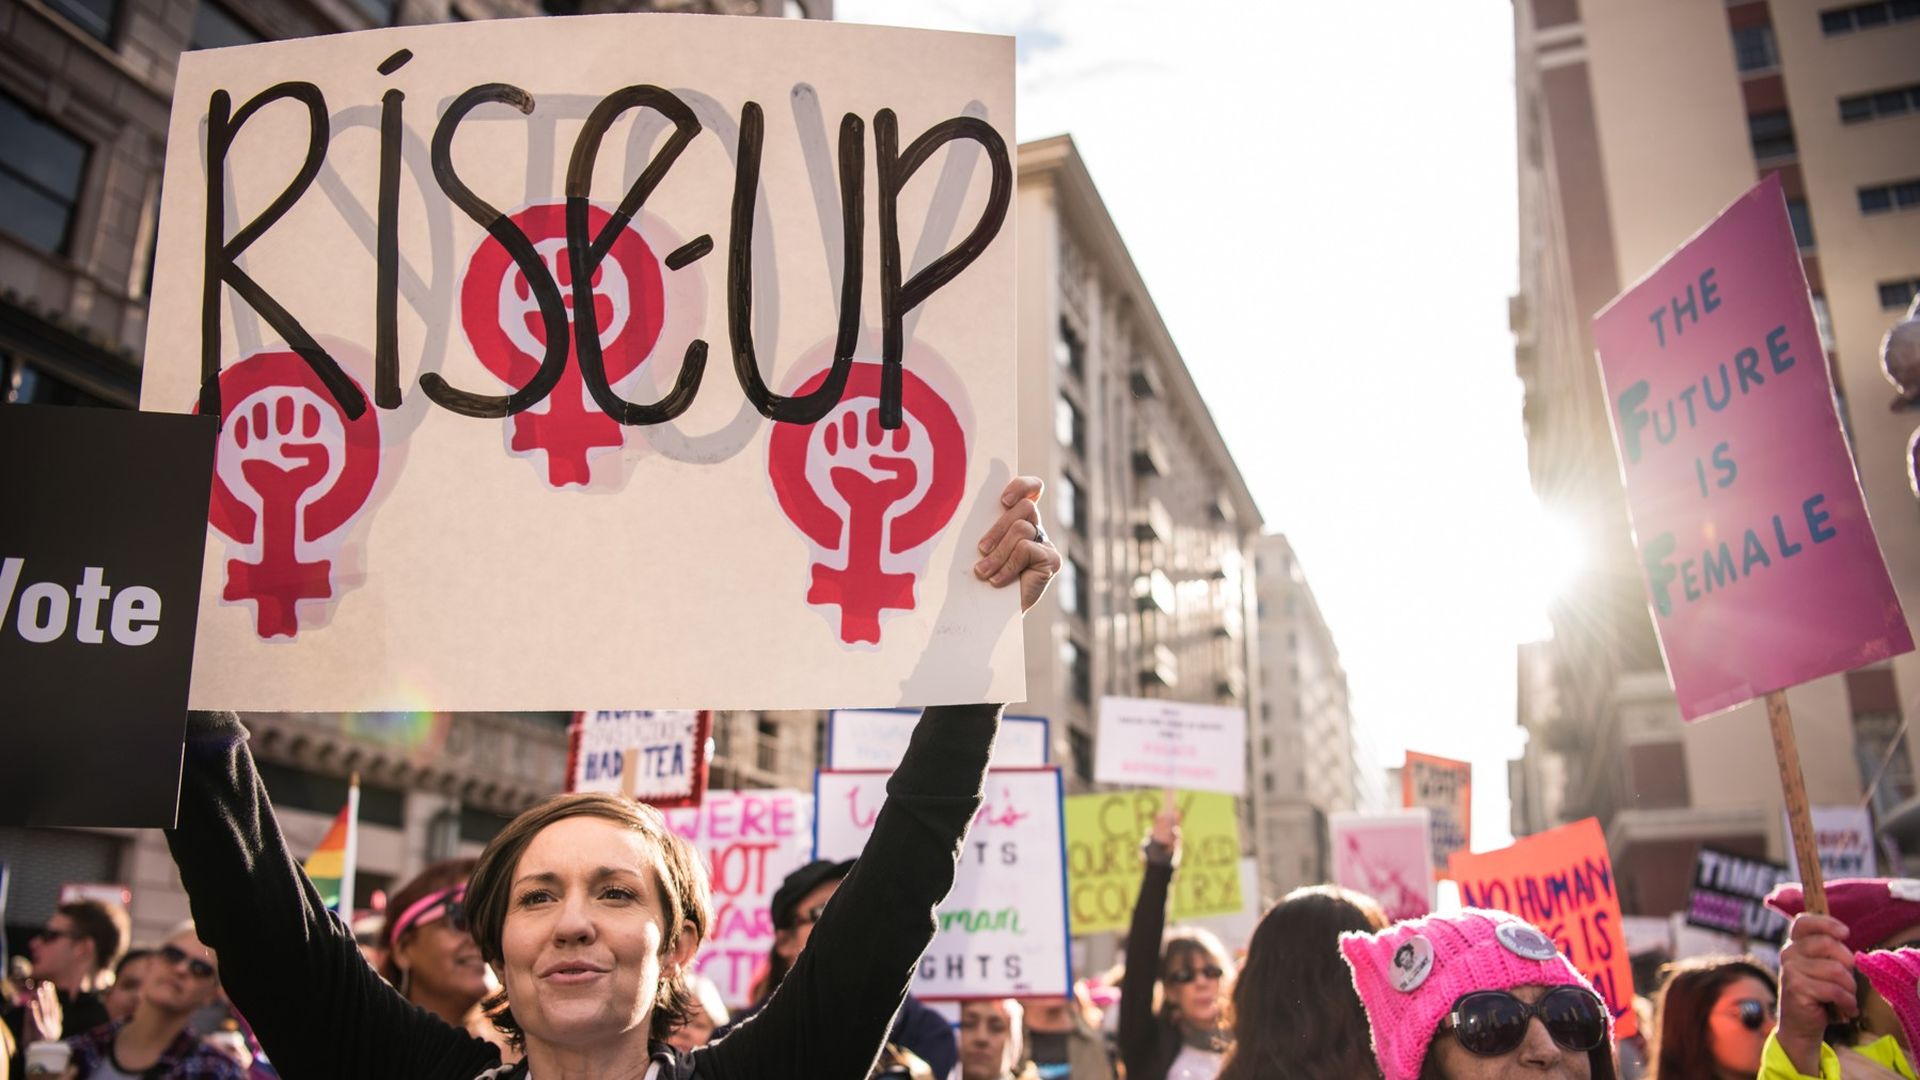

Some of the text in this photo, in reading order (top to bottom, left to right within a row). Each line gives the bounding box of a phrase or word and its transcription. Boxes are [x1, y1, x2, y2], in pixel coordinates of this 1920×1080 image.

[1649, 267, 1722, 348] THE
[1617, 324, 1797, 463] FUTURE
[1695, 441, 1738, 498] IS
[1642, 493, 1837, 618] FEMALE
[586, 743, 684, 780] HAD TEA
[1463, 857, 1612, 922] NO HUMAN
[1579, 911, 1612, 961] IS
